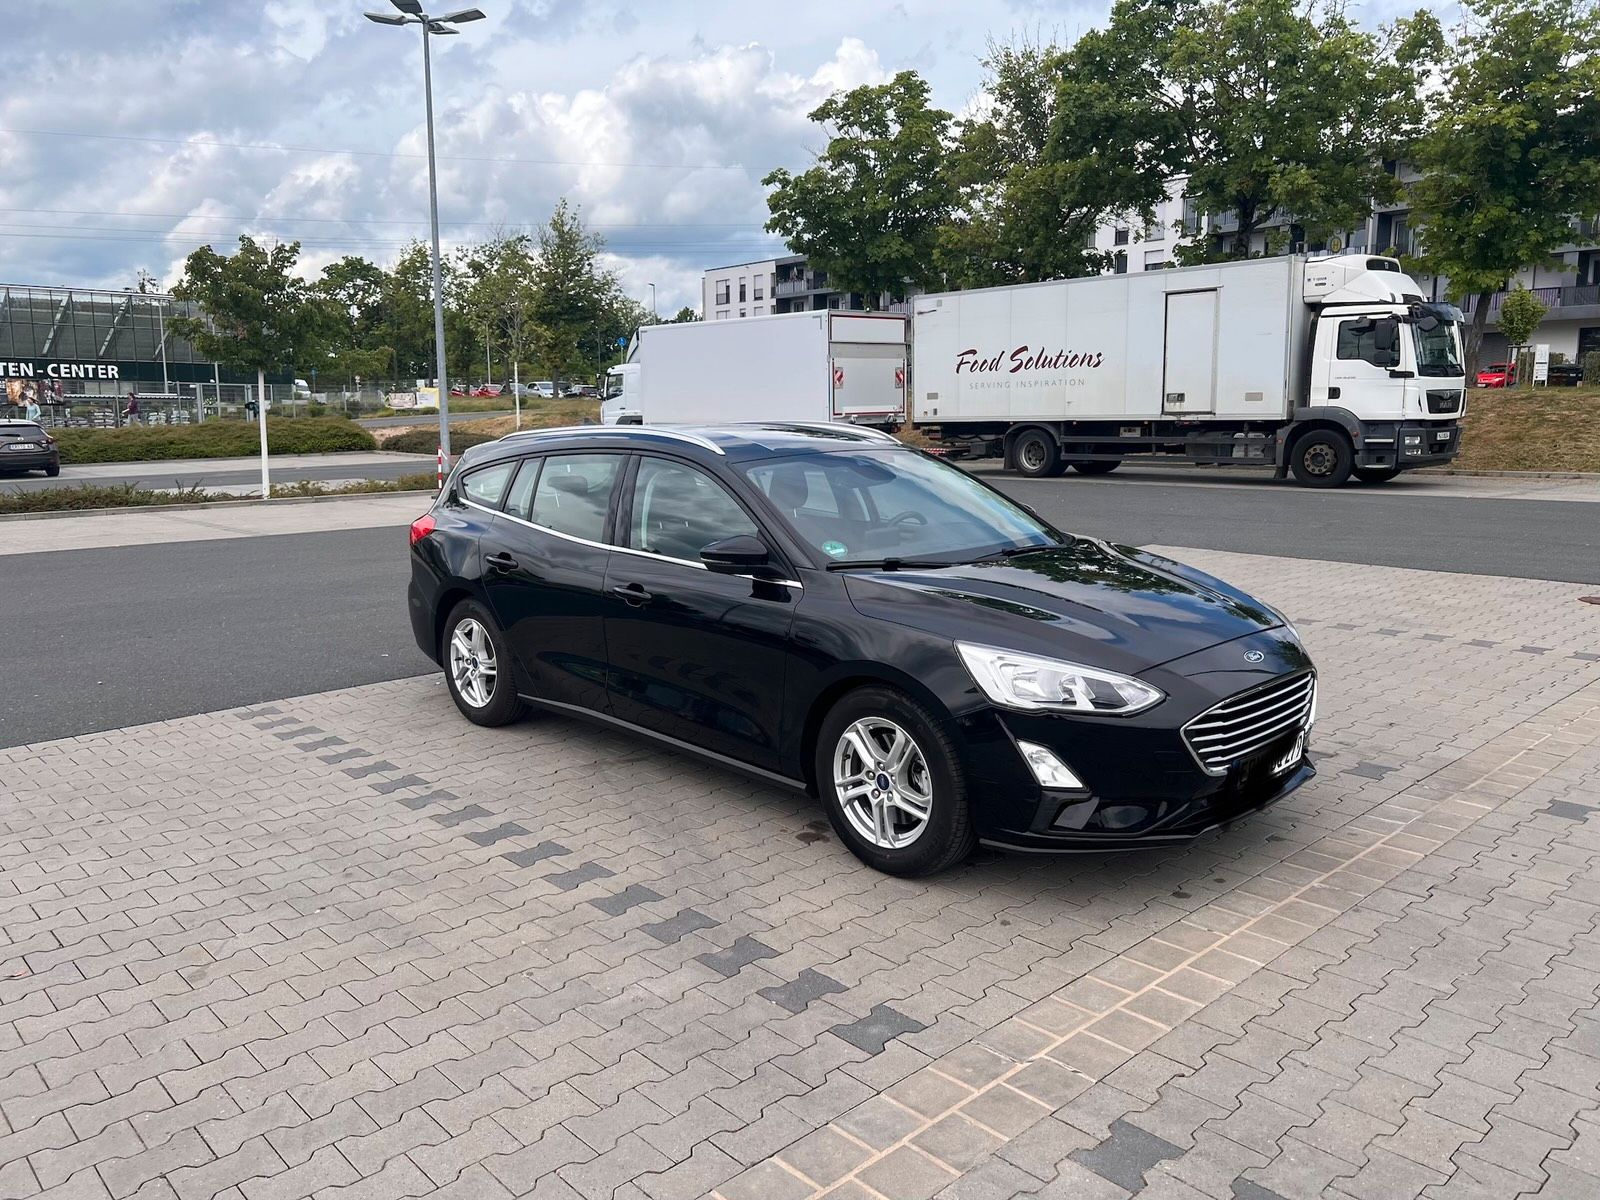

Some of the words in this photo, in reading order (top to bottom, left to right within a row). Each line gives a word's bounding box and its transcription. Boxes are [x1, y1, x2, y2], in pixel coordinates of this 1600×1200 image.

[956, 349, 1005, 374] Food
[1009, 345, 1105, 374] Solutions
[969, 381, 1010, 390] SERVING
[1016, 378, 1085, 388] INSPIRATION
